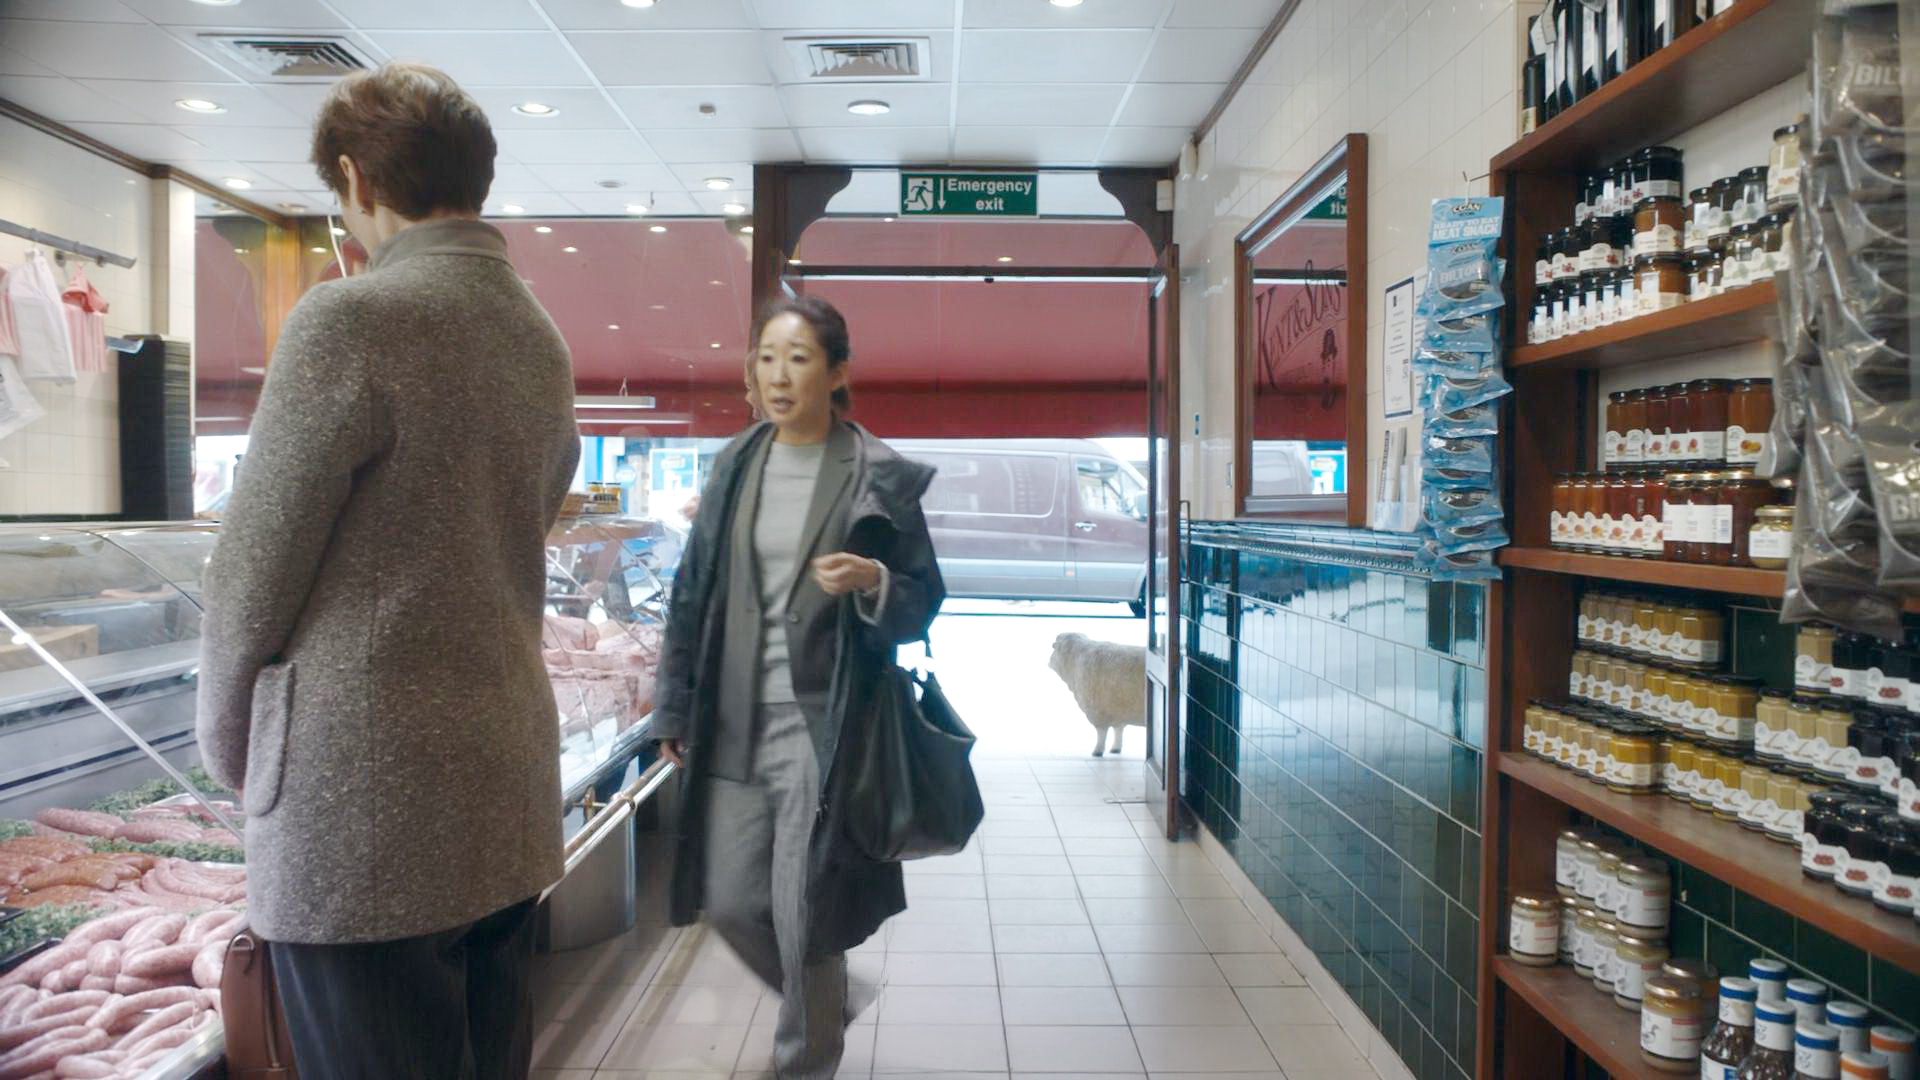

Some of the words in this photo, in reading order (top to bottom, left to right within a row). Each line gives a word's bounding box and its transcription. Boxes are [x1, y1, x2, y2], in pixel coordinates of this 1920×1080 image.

[947, 177, 1032, 195] Emergency
[975, 198, 1004, 211] exit
[1432, 227, 1460, 240] MEAT
[1463, 222, 1499, 238] SNACK
